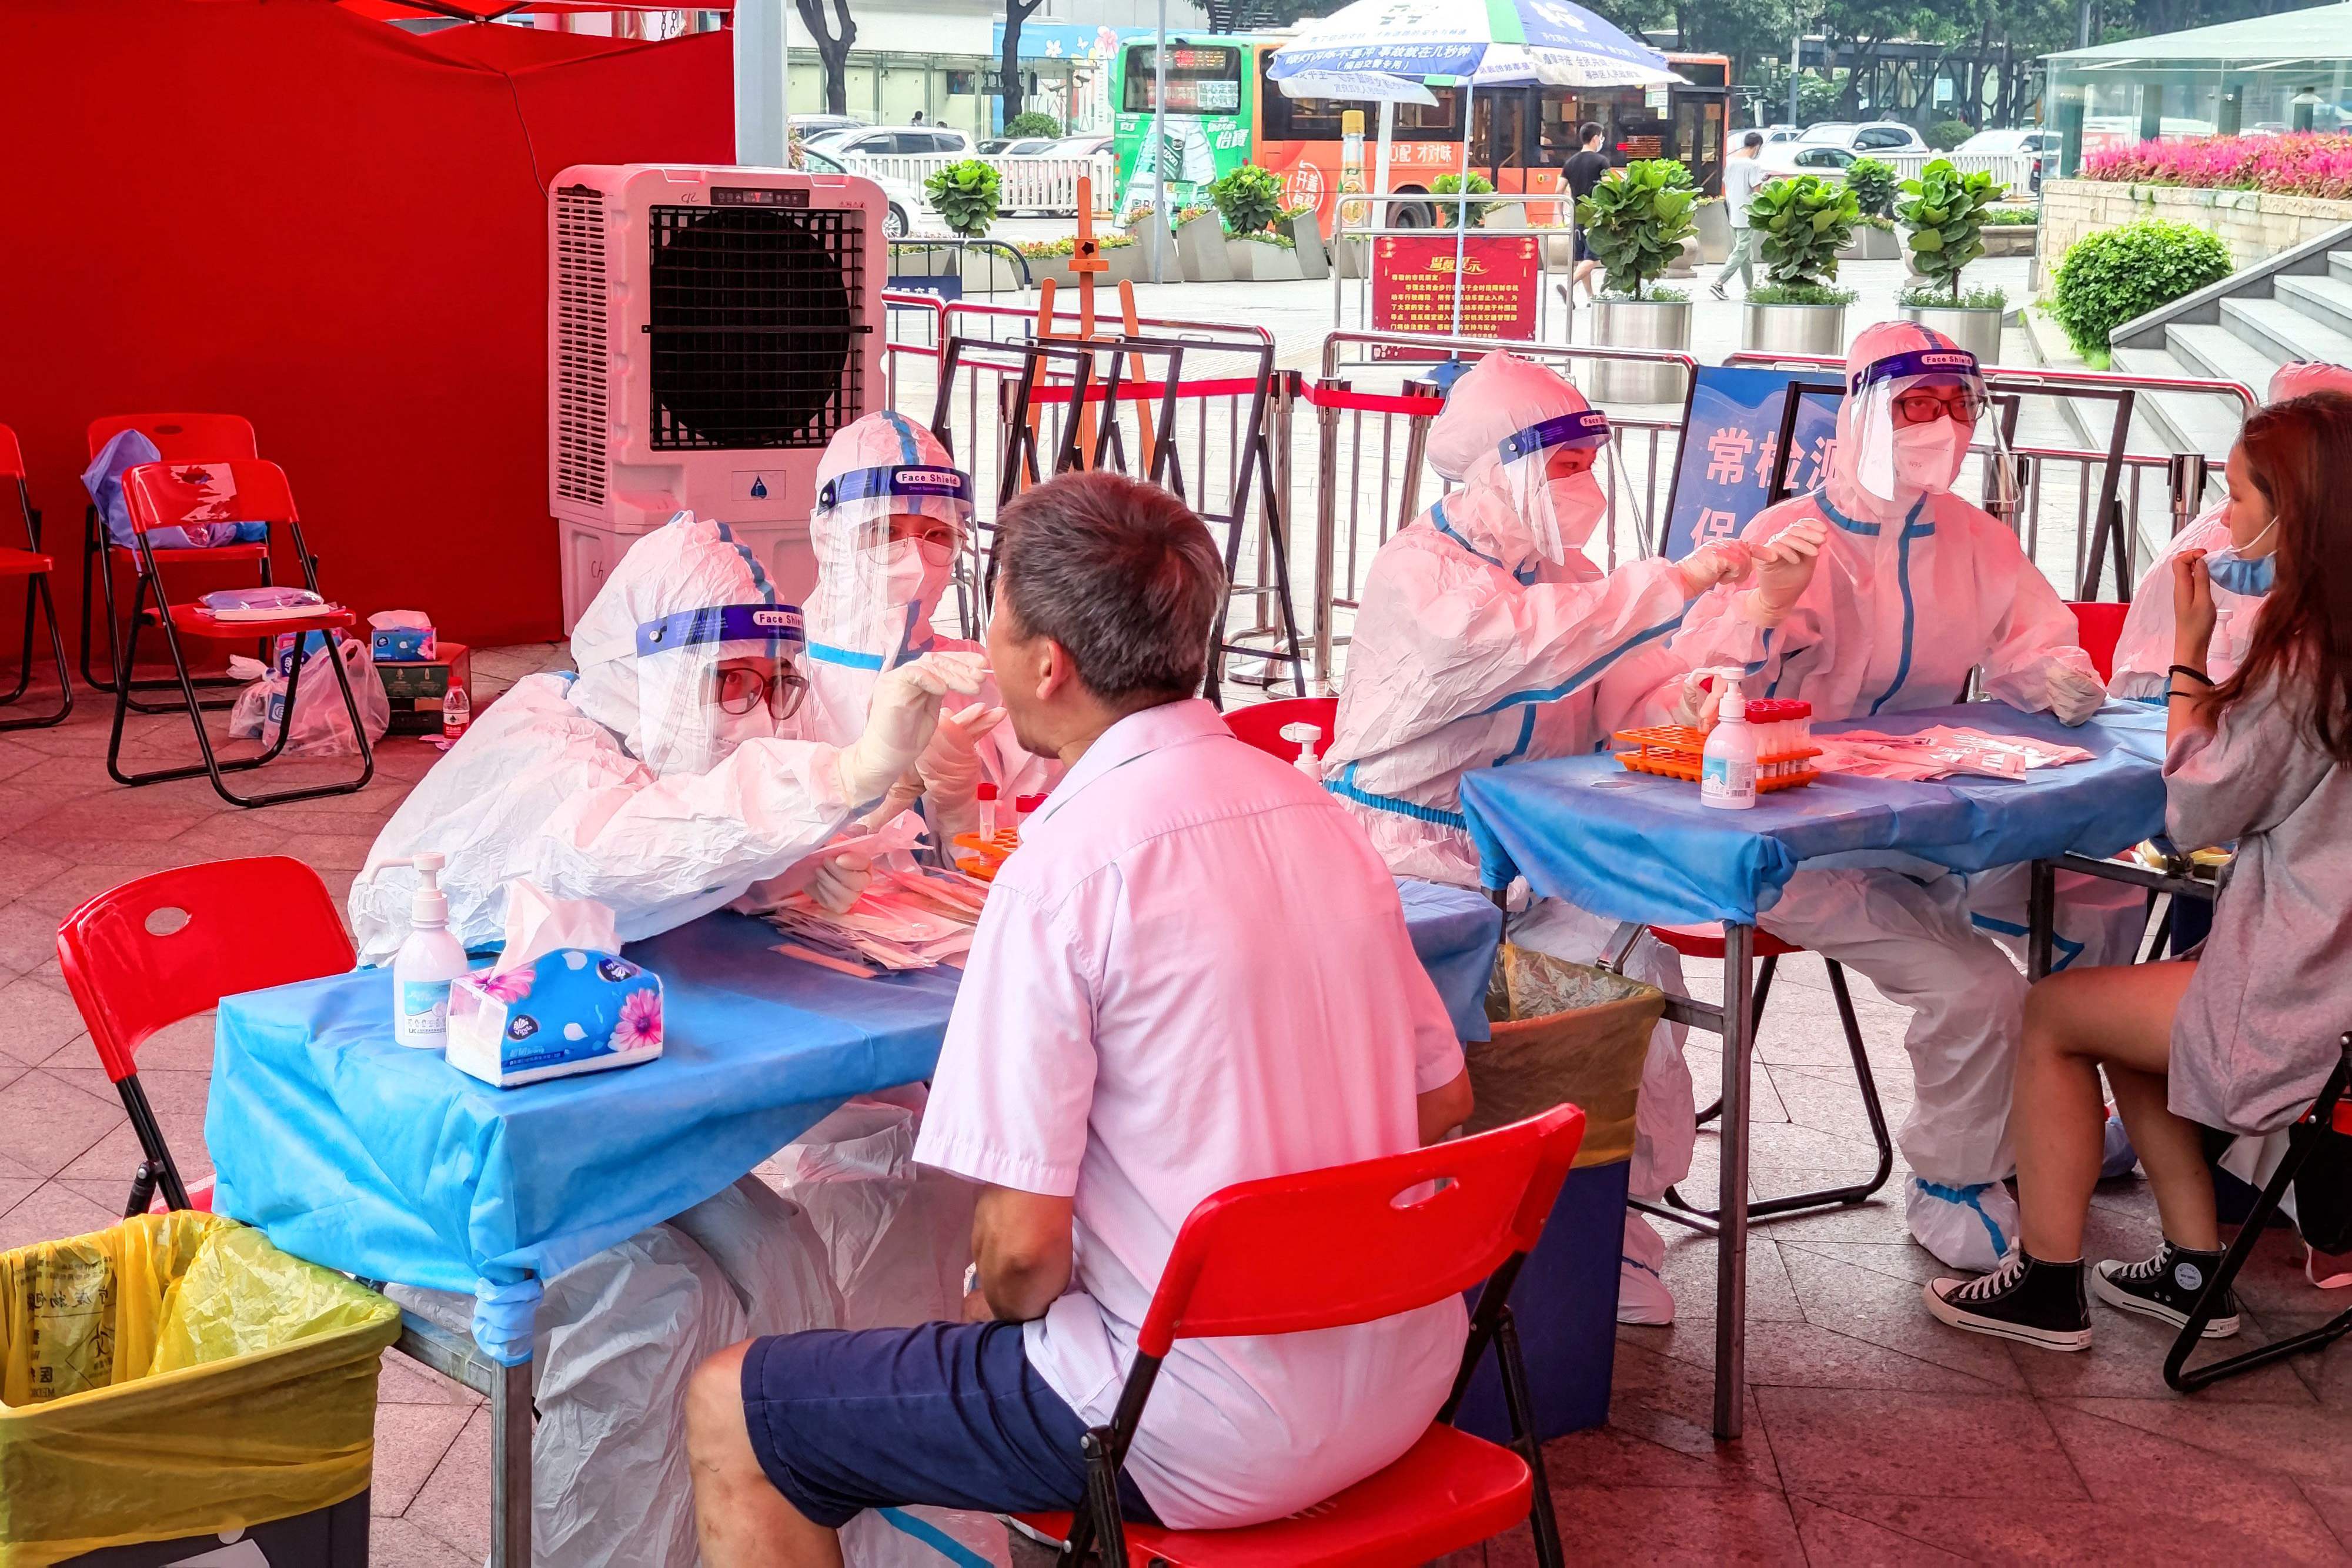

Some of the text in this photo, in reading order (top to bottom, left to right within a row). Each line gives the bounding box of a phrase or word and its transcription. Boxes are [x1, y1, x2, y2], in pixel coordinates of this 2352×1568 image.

[1296, 170, 1318, 192] 开盖
[901, 473, 958, 484] Face Shield
[759, 614, 783, 623] Face
